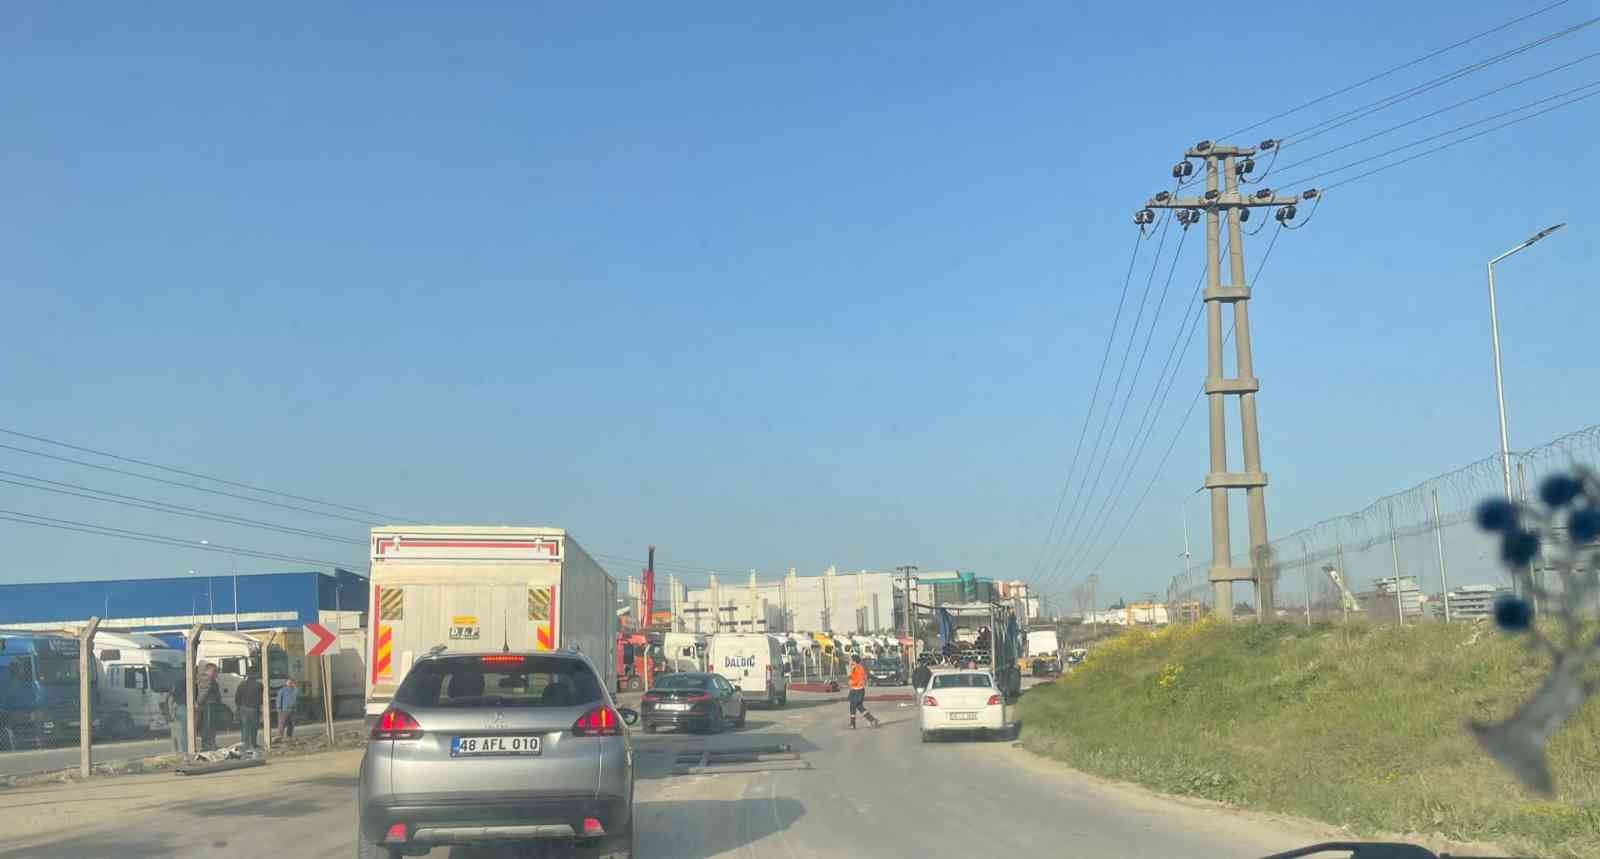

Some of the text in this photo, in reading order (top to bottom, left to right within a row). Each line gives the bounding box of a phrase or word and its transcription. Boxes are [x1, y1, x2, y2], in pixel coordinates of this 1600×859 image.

[460, 737, 538, 752] 48 AFL 010
